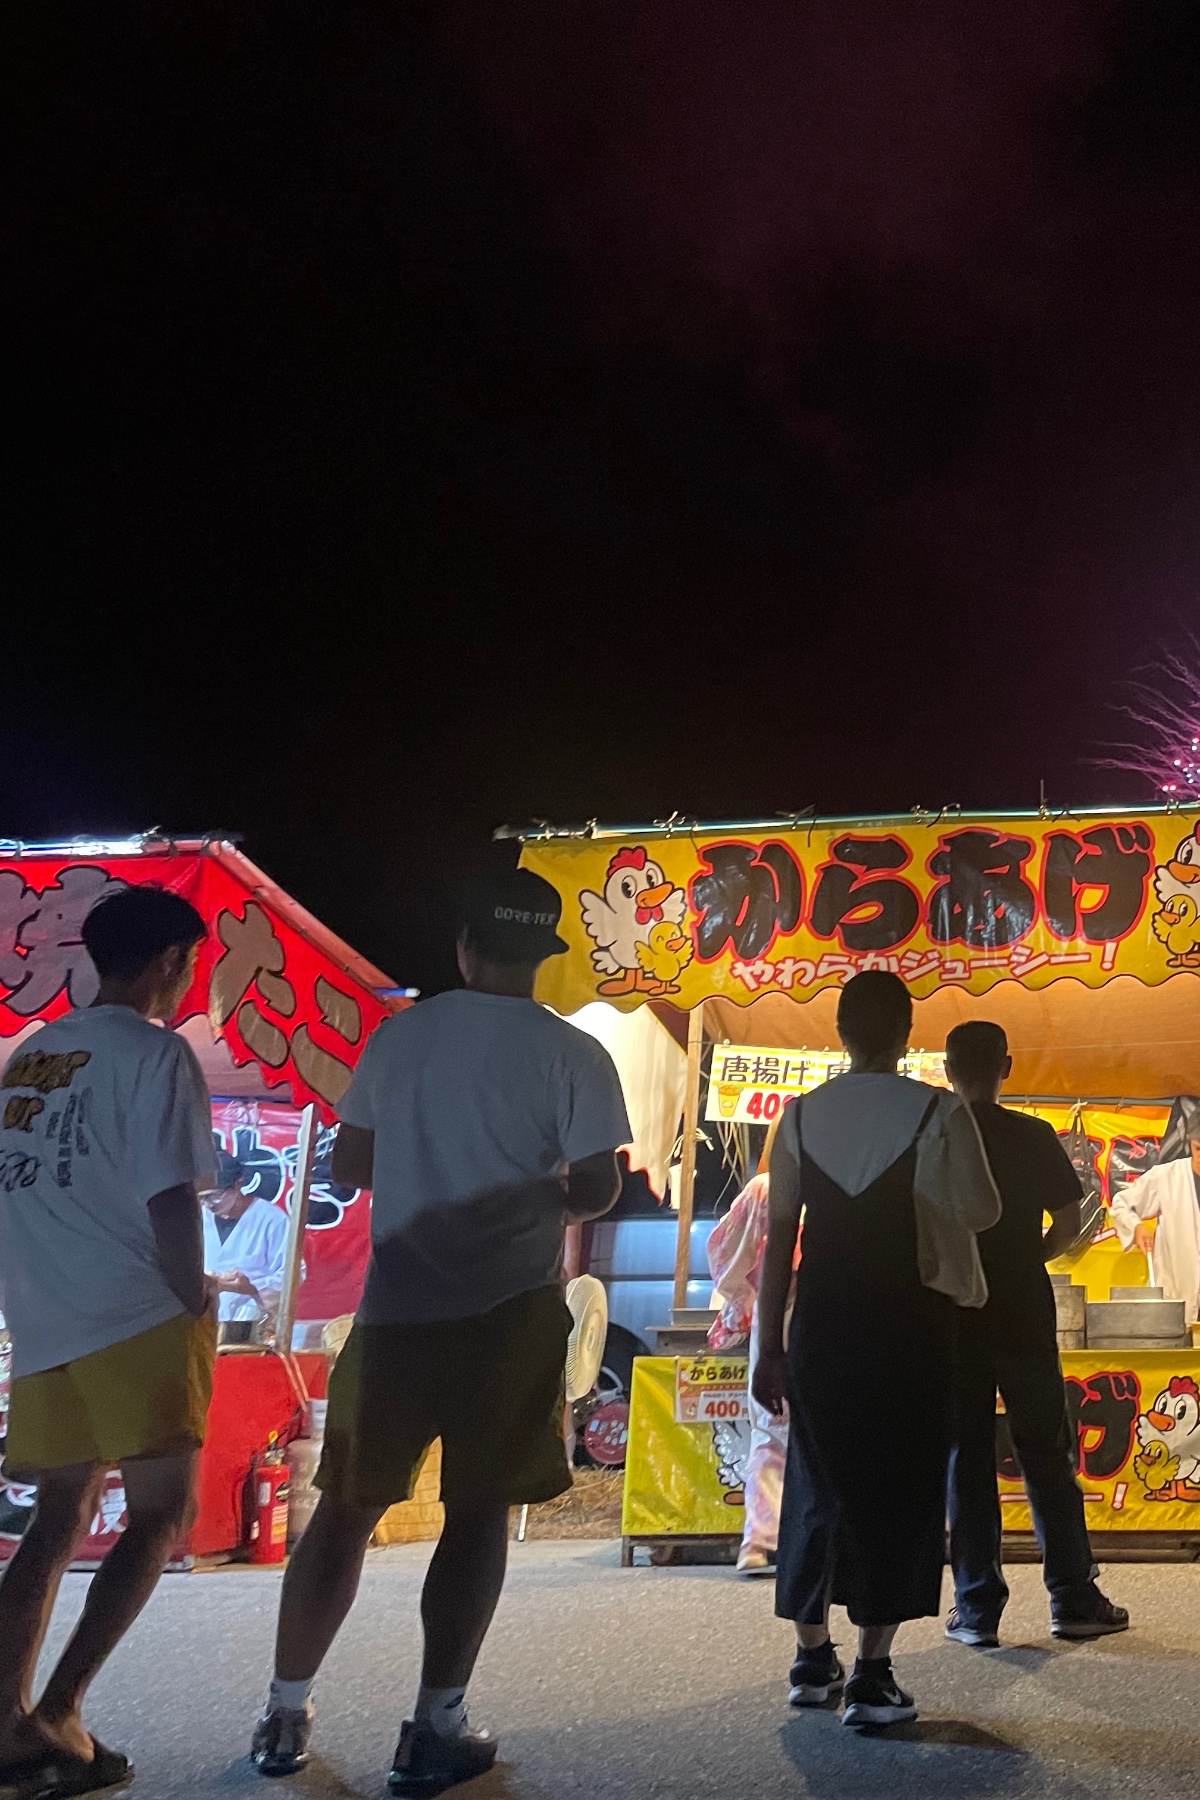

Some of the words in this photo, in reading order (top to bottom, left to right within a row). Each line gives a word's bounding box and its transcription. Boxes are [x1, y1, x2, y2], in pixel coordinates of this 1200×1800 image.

[687, 822, 1156, 961] からあげ
[721, 1055, 812, 1086] 唐揚げ
